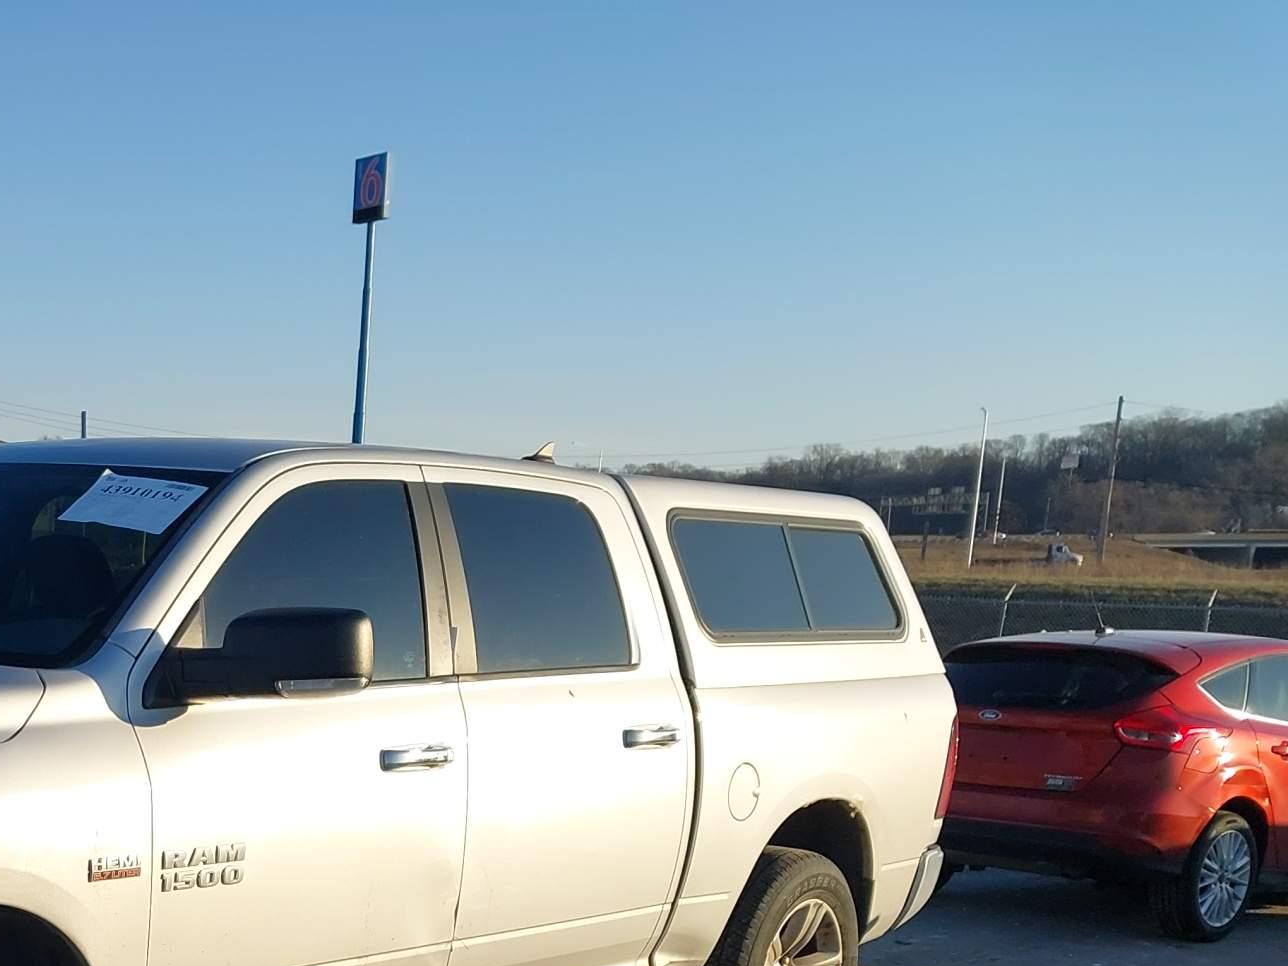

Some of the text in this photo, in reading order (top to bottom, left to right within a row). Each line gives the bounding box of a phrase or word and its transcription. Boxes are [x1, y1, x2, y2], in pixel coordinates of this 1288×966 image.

[359, 157, 384, 208] 6
[100, 484, 185, 502] 43910194
[88, 854, 142, 871] HEMI
[161, 842, 246, 870] RAM
[160, 865, 244, 893] 1500
